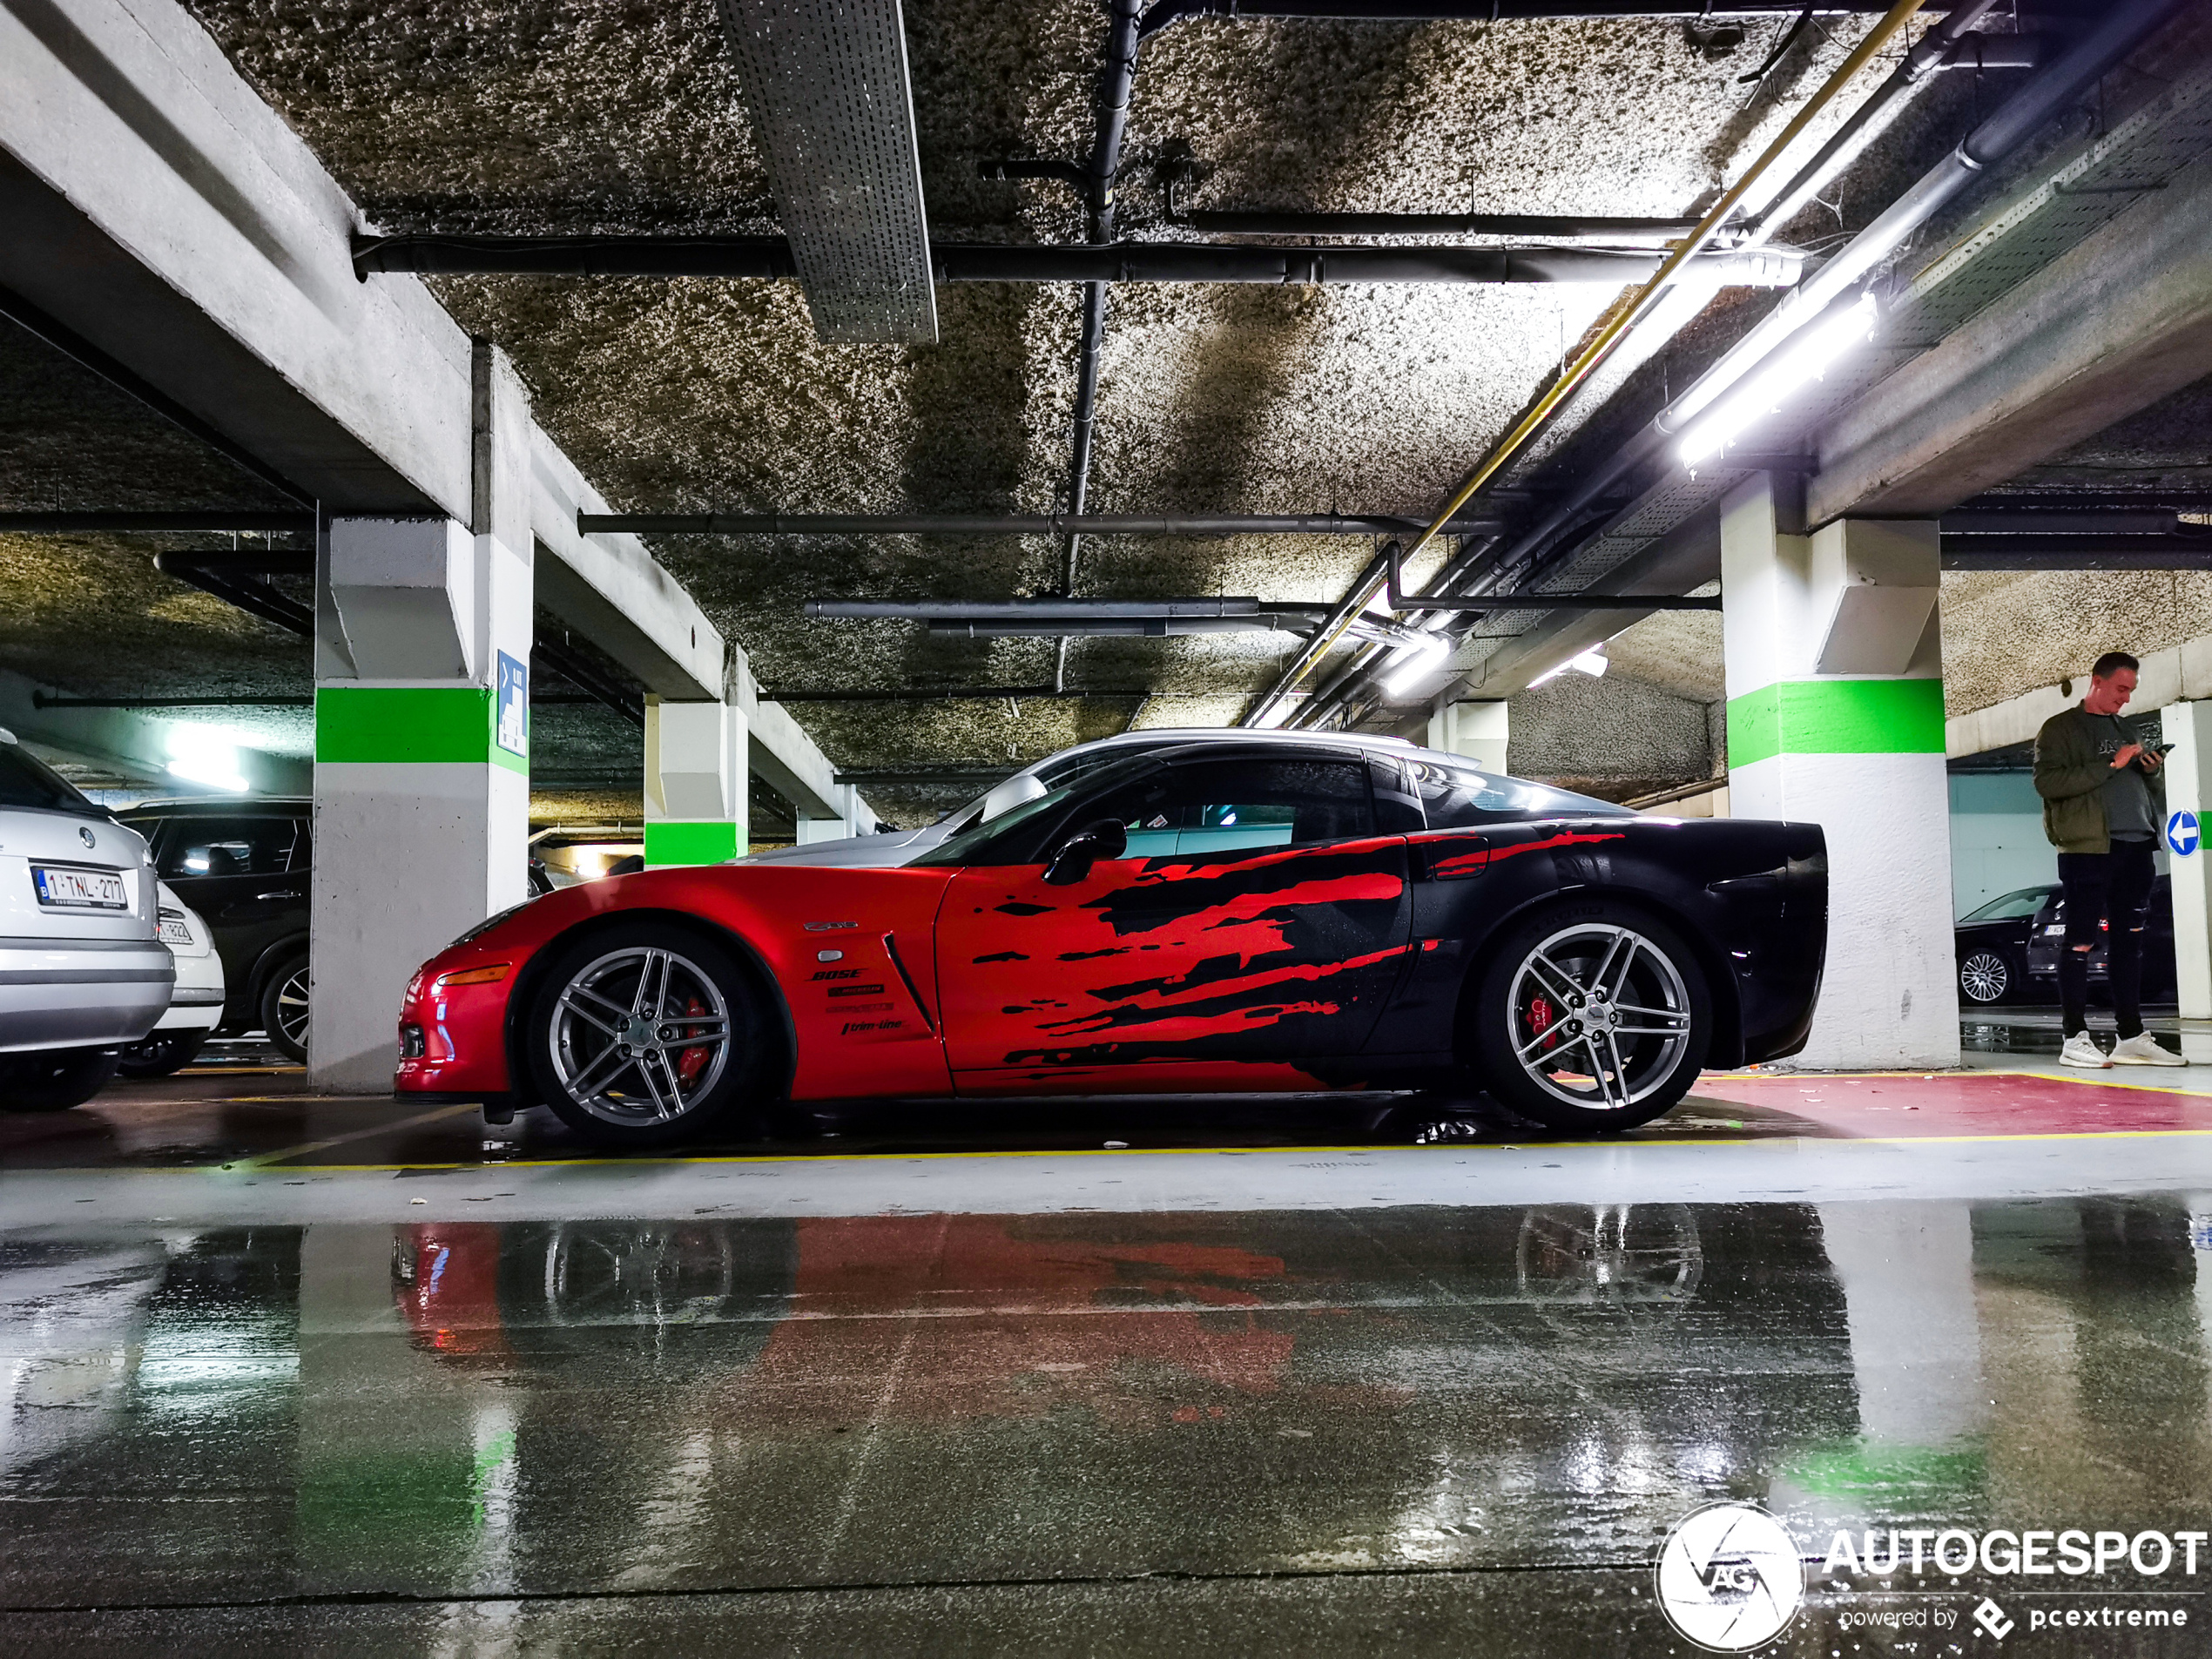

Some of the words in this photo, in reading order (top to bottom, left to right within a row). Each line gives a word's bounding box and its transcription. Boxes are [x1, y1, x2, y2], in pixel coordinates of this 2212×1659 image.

[41, 887, 48, 897] B
[806, 968, 867, 981] BOSE
[850, 1019, 903, 1032] trim-line
